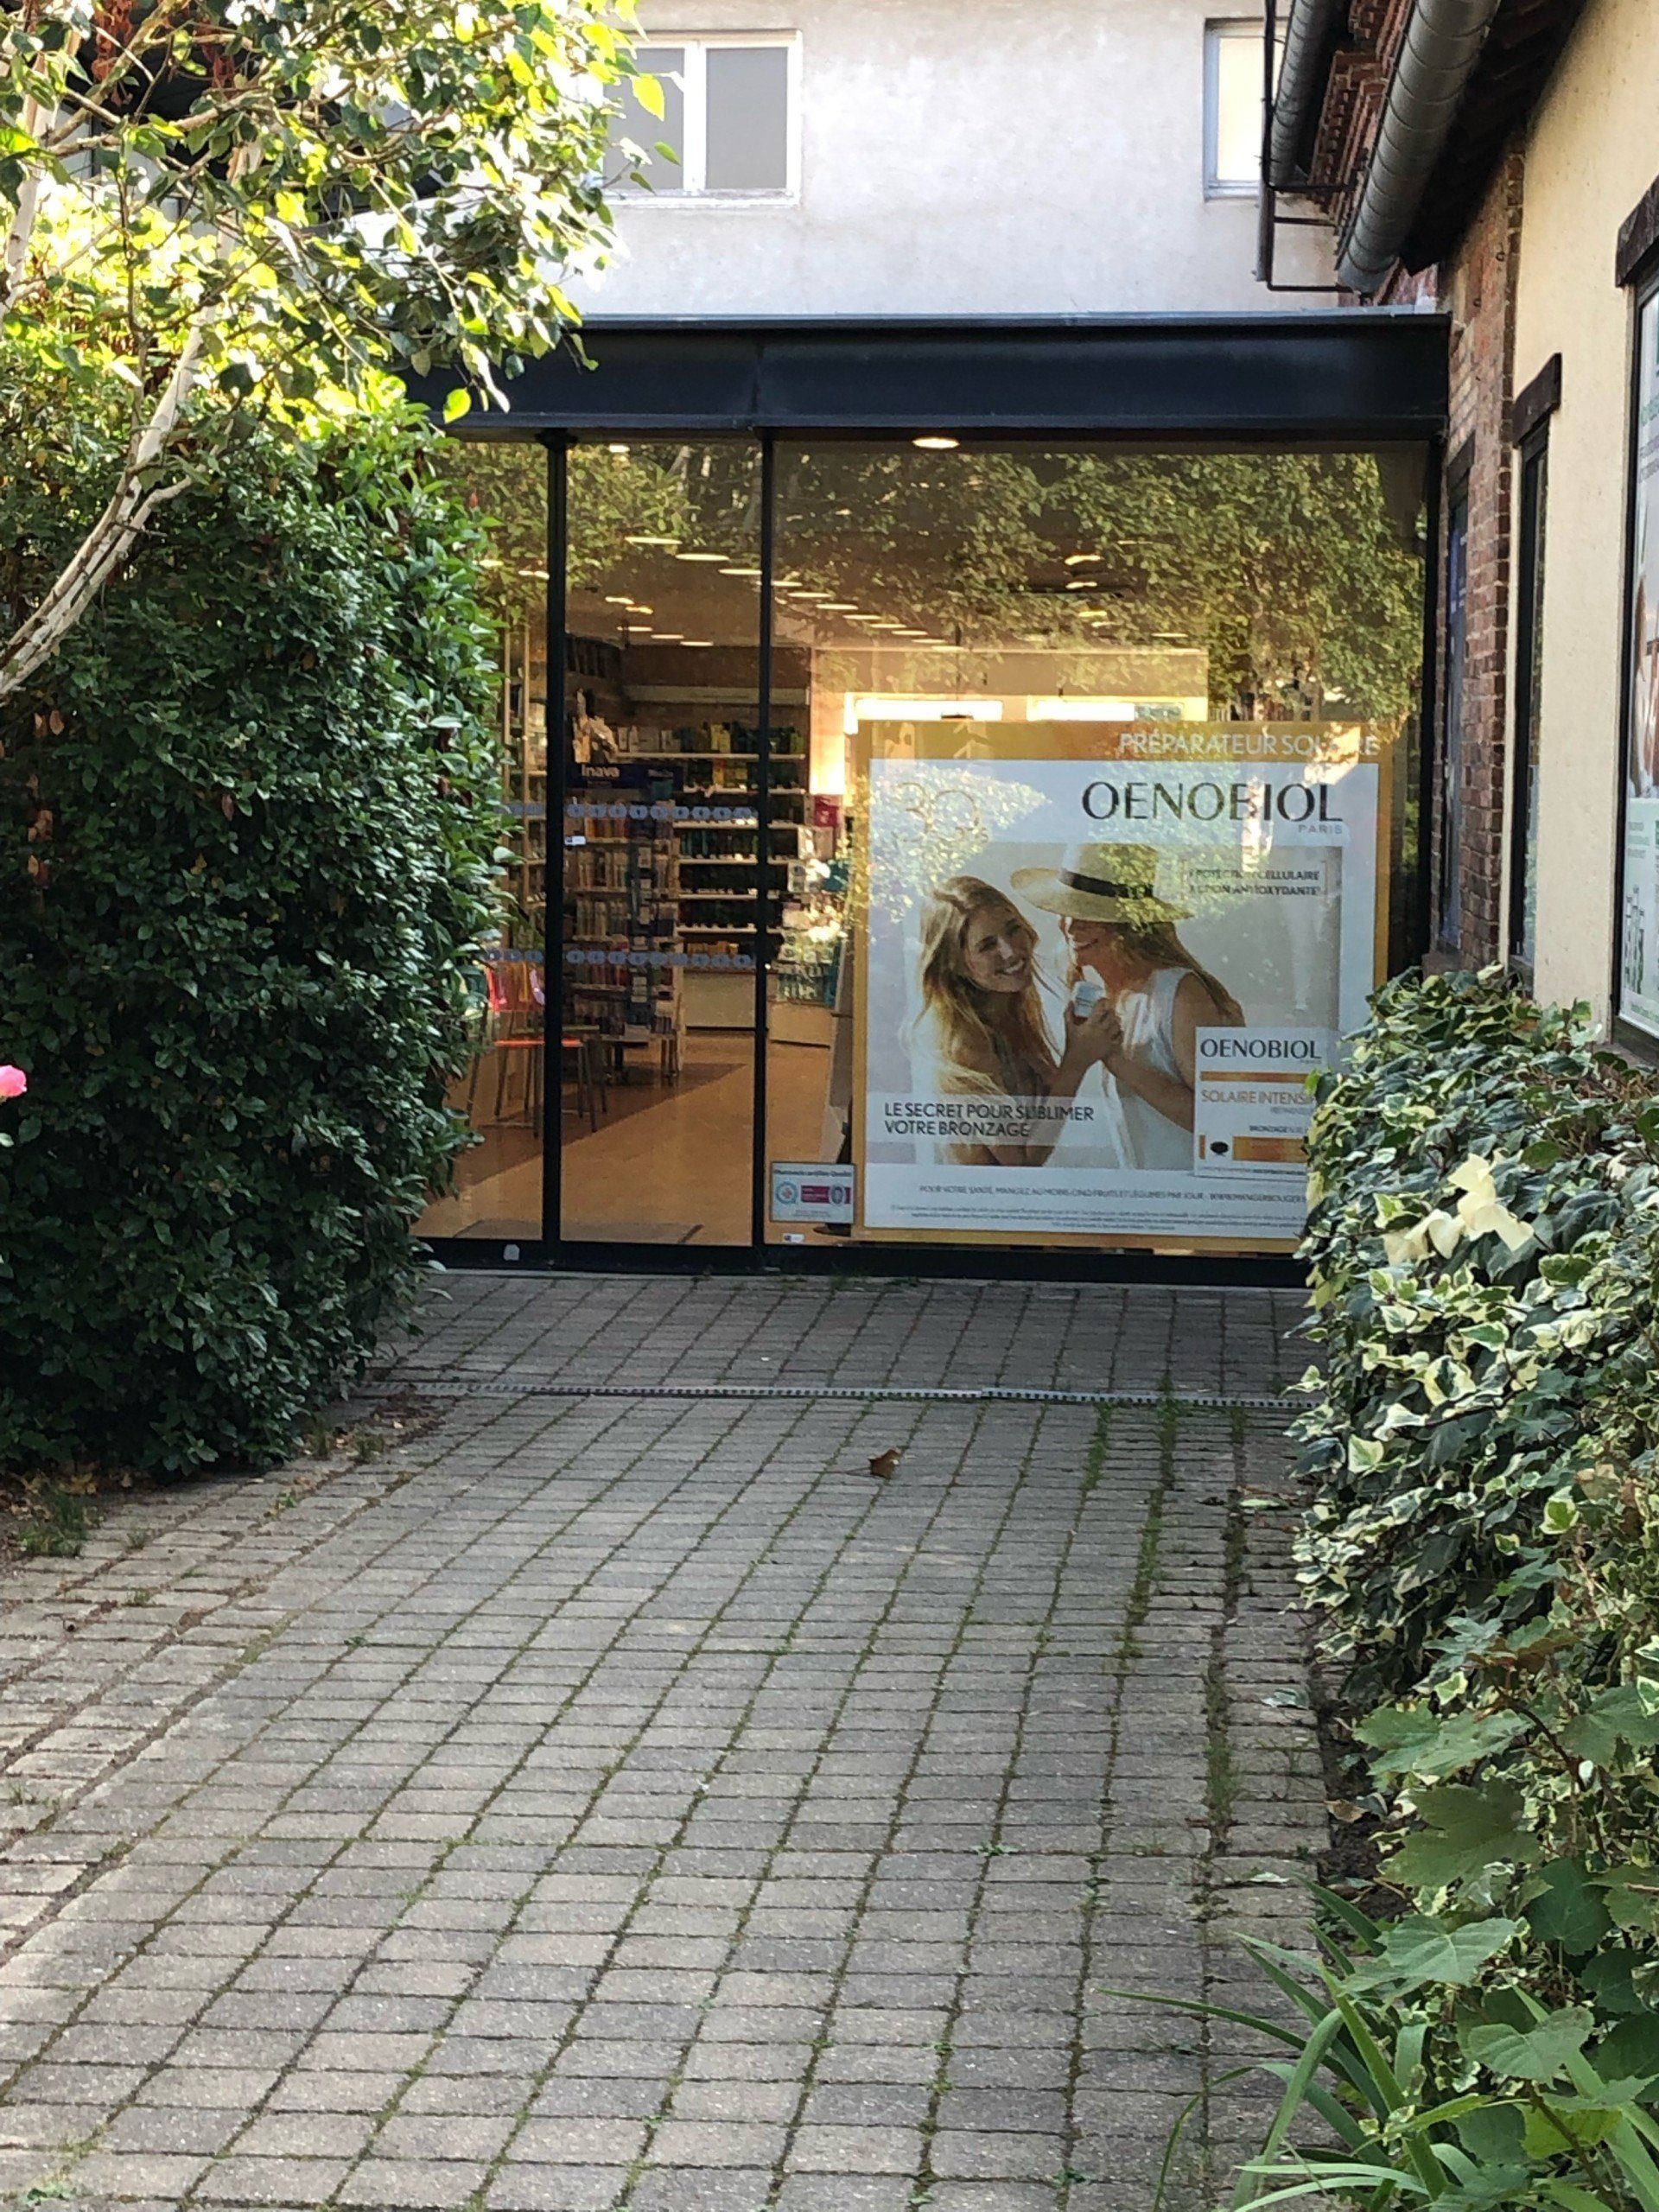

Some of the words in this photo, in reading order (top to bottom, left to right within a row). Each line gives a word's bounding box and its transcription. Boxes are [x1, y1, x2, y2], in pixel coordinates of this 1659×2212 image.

[1281, 734, 1381, 756] SOLE
[1083, 781, 1343, 822] OENOBIOL
[1298, 824, 1343, 835] PARIS
[1200, 1039, 1322, 1059] OENOBIOL
[1201, 1090, 1256, 1103] SOLAIRE
[1259, 1091, 1315, 1105] INTENSI
[885, 1103, 902, 1117] LE
[906, 1103, 963, 1118] SECRET
[967, 1104, 1014, 1119] POUR
[1017, 1105, 1095, 1121] SUBLIMER
[885, 1120, 935, 1135] VOTRE
[938, 1121, 1030, 1137] BRONZAGE
